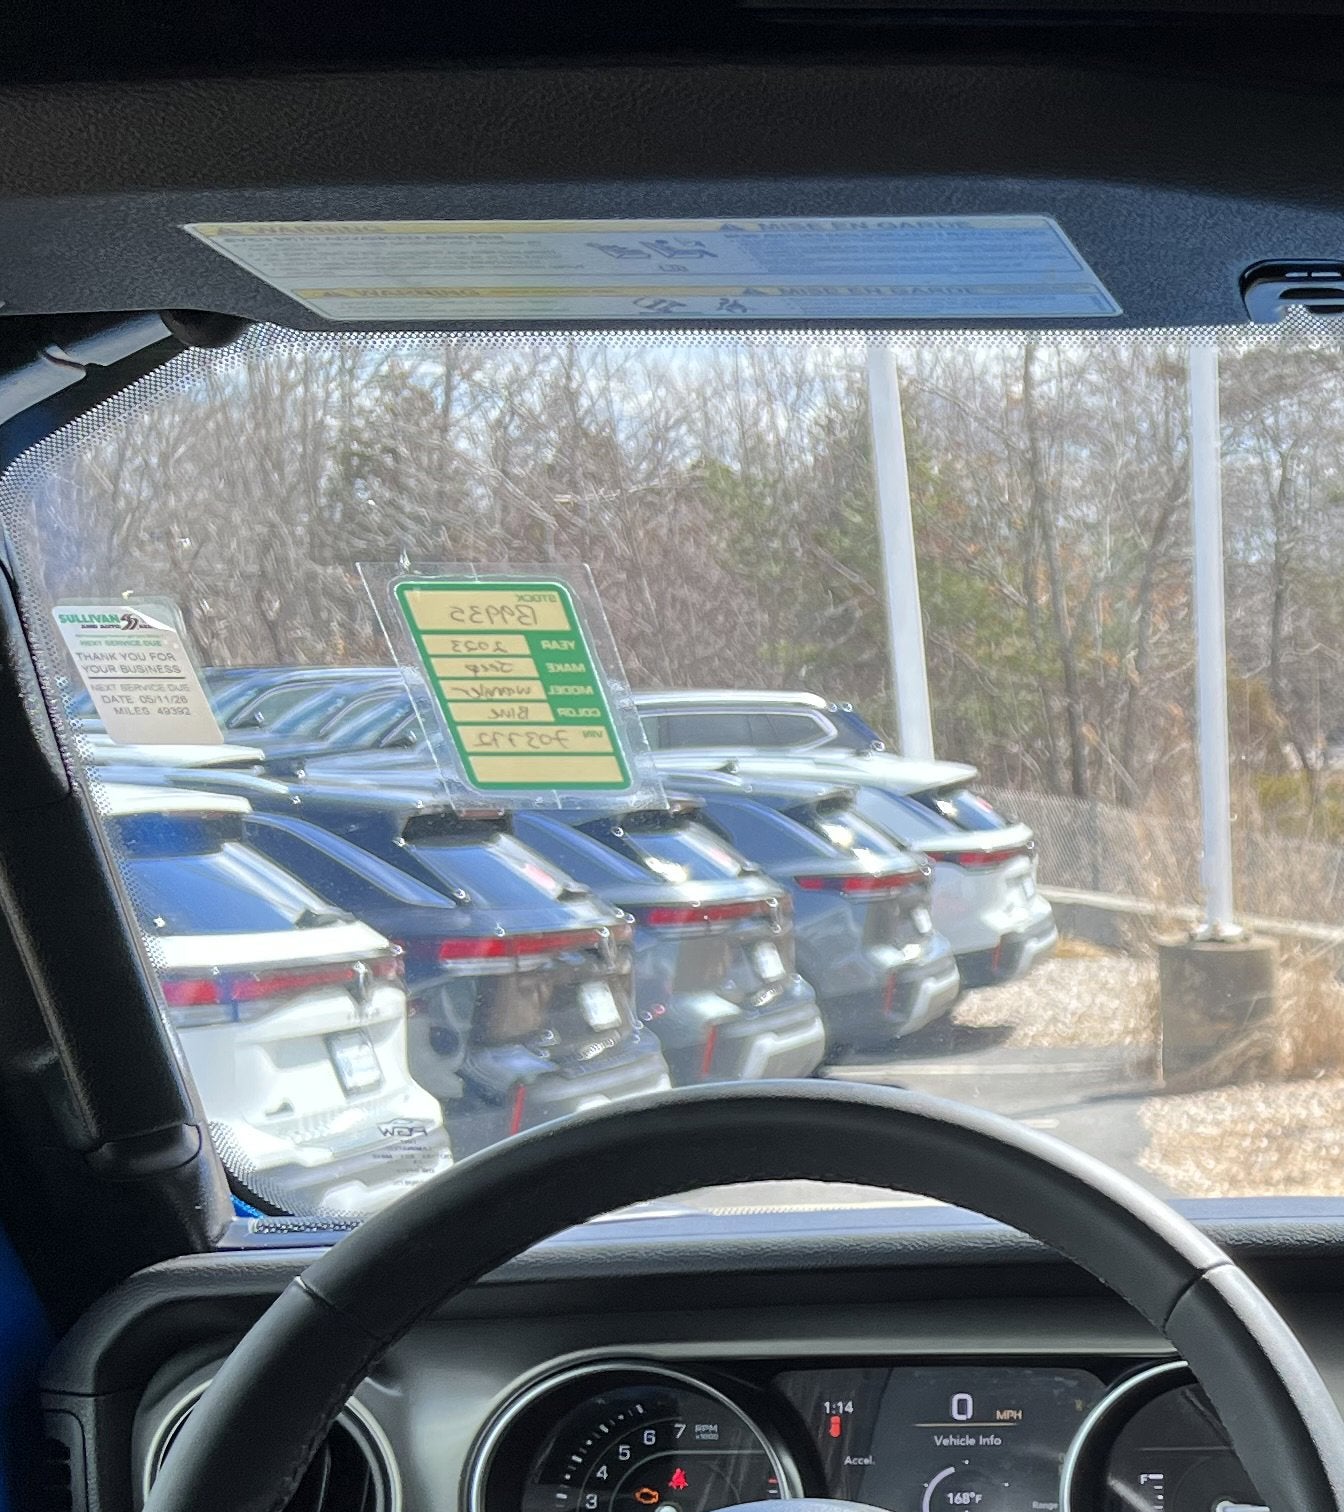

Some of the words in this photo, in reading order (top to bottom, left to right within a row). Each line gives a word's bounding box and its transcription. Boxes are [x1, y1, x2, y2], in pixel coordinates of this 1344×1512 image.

[251, 225, 383, 236] WARNING
[58, 613, 121, 624] SULLIVAN
[76, 652, 117, 662] THANK
[120, 652, 147, 661] YOU
[149, 652, 177, 661] FOR
[81, 665, 117, 674] YOUR
[120, 665, 182, 674] BUSINESS
[91, 684, 117, 692] NEXT
[120, 684, 167, 692] SERVICE
[168, 684, 190, 692] DUE
[824, 1401, 854, 1414] 1:14
[951, 1392, 974, 1421] 0
[995, 1410, 1023, 1421] MPH
[674, 1423, 687, 1439] 7
[643, 1430, 656, 1446] 6
[934, 1435, 976, 1447] Vehicle
[978, 1435, 1003, 1447] Info
[618, 1445, 631, 1461] 5
[844, 1455, 876, 1465] Accel.
[596, 1465, 609, 1480] 4
[1139, 1474, 1148, 1485] F
[585, 1493, 598, 1510] 3
[1032, 1501, 1058, 1511] Range
